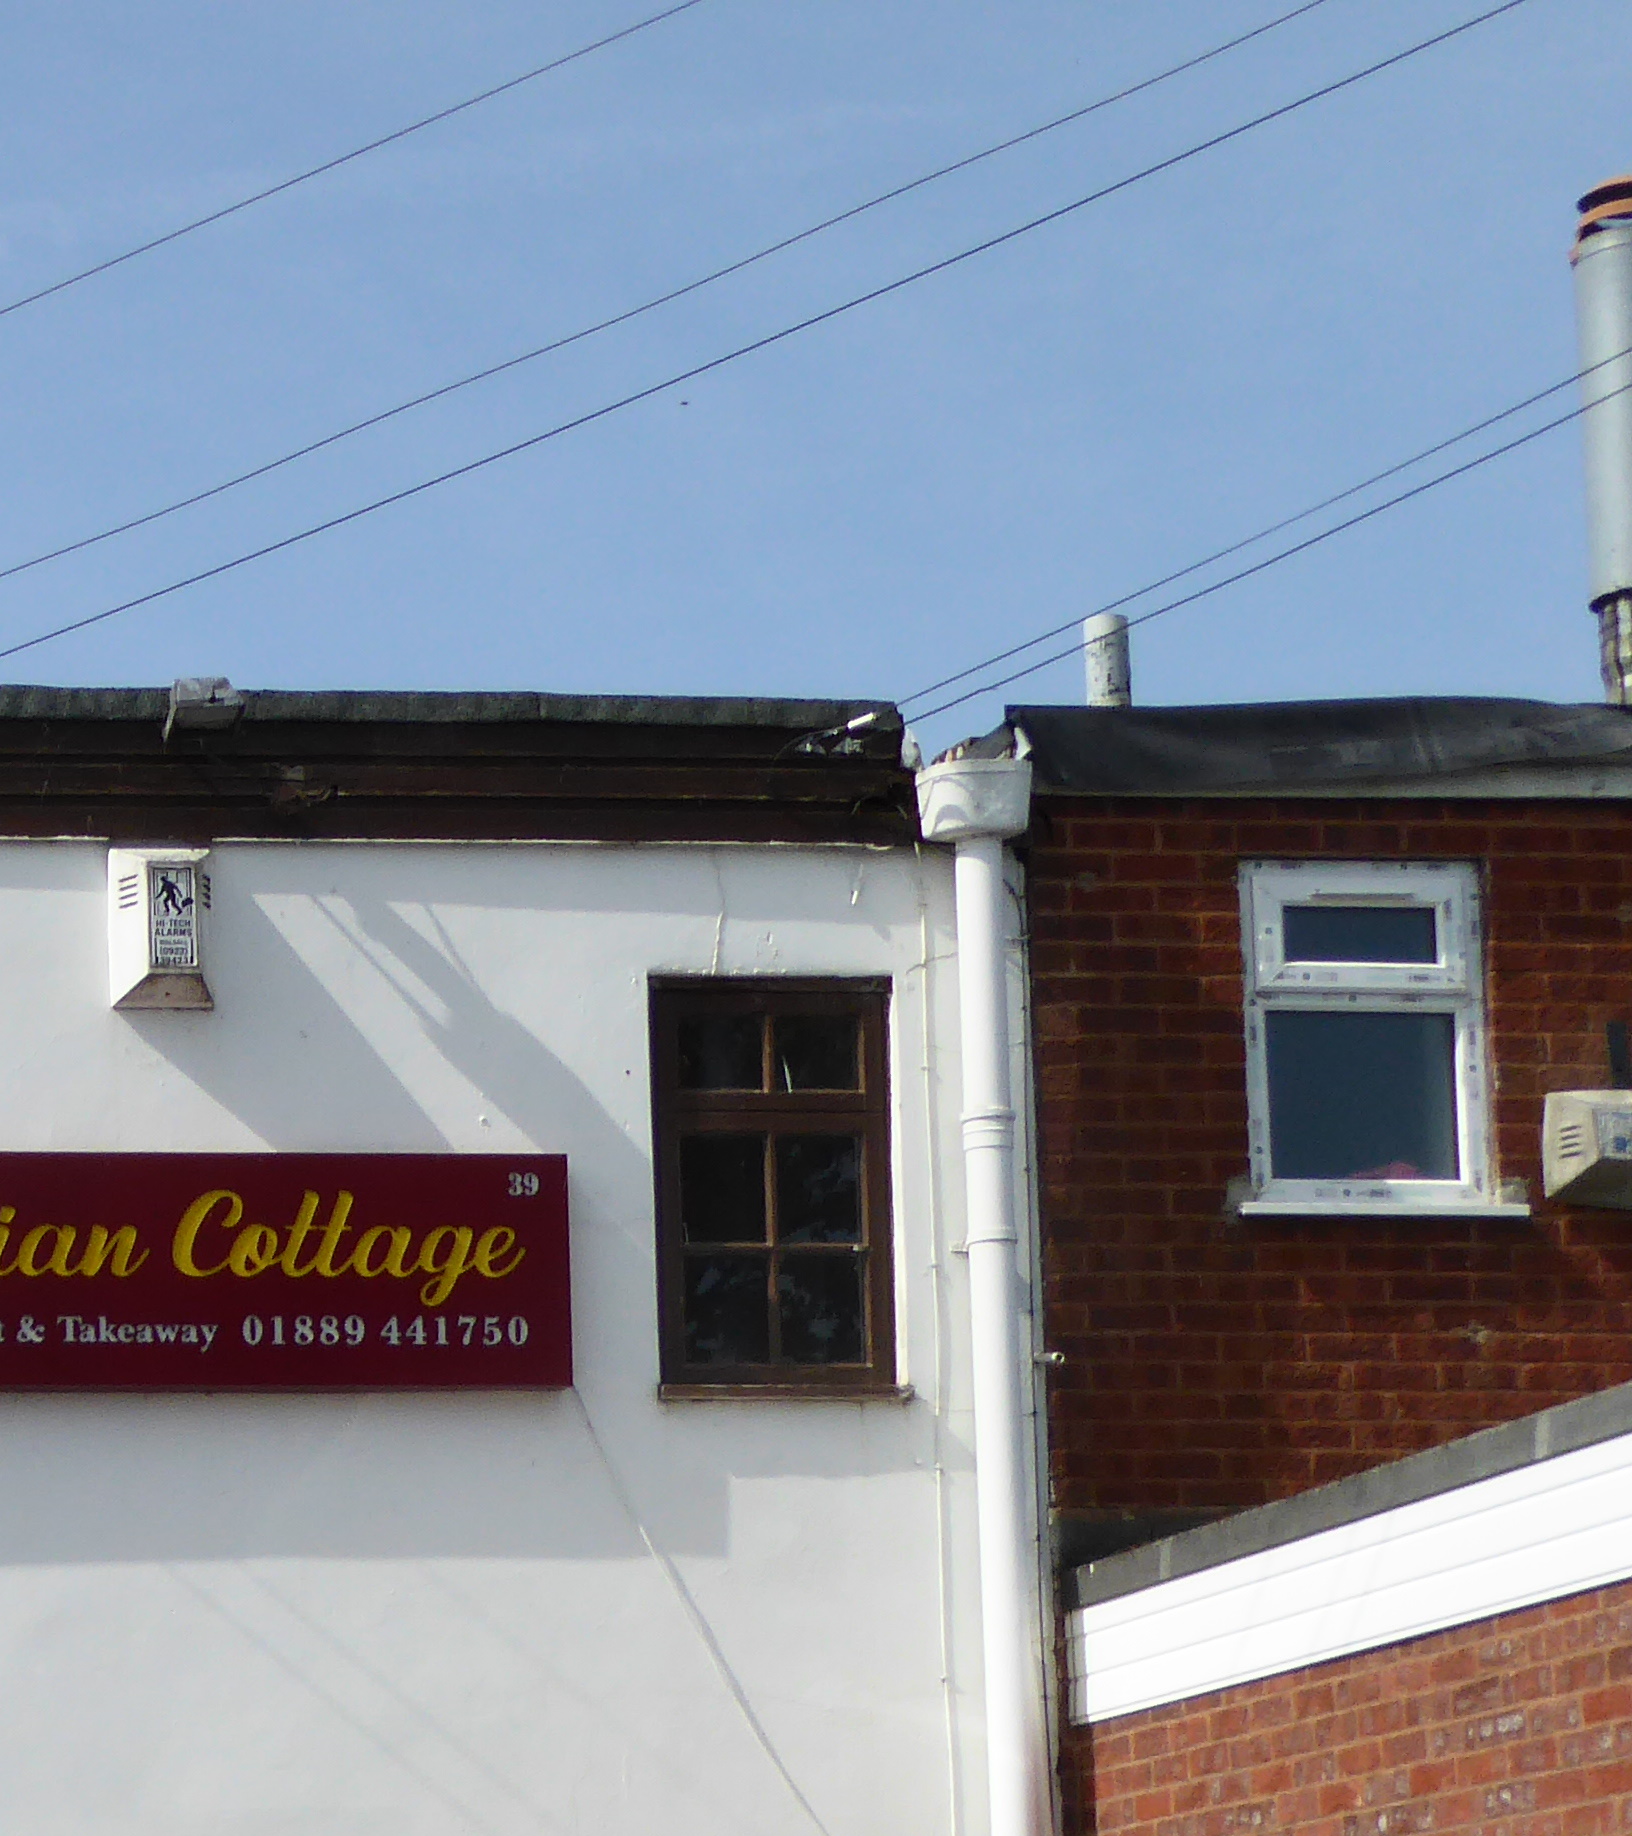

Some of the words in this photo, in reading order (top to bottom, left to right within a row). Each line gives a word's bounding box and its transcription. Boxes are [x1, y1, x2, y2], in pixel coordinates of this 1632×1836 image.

[508, 1173, 539, 1196] 39
[172, 1189, 526, 1306] Cottage
[16, 1314, 45, 1343] &
[57, 1315, 218, 1353] Takeaway
[242, 1315, 366, 1346] 01889
[381, 1315, 529, 1346] 441750
